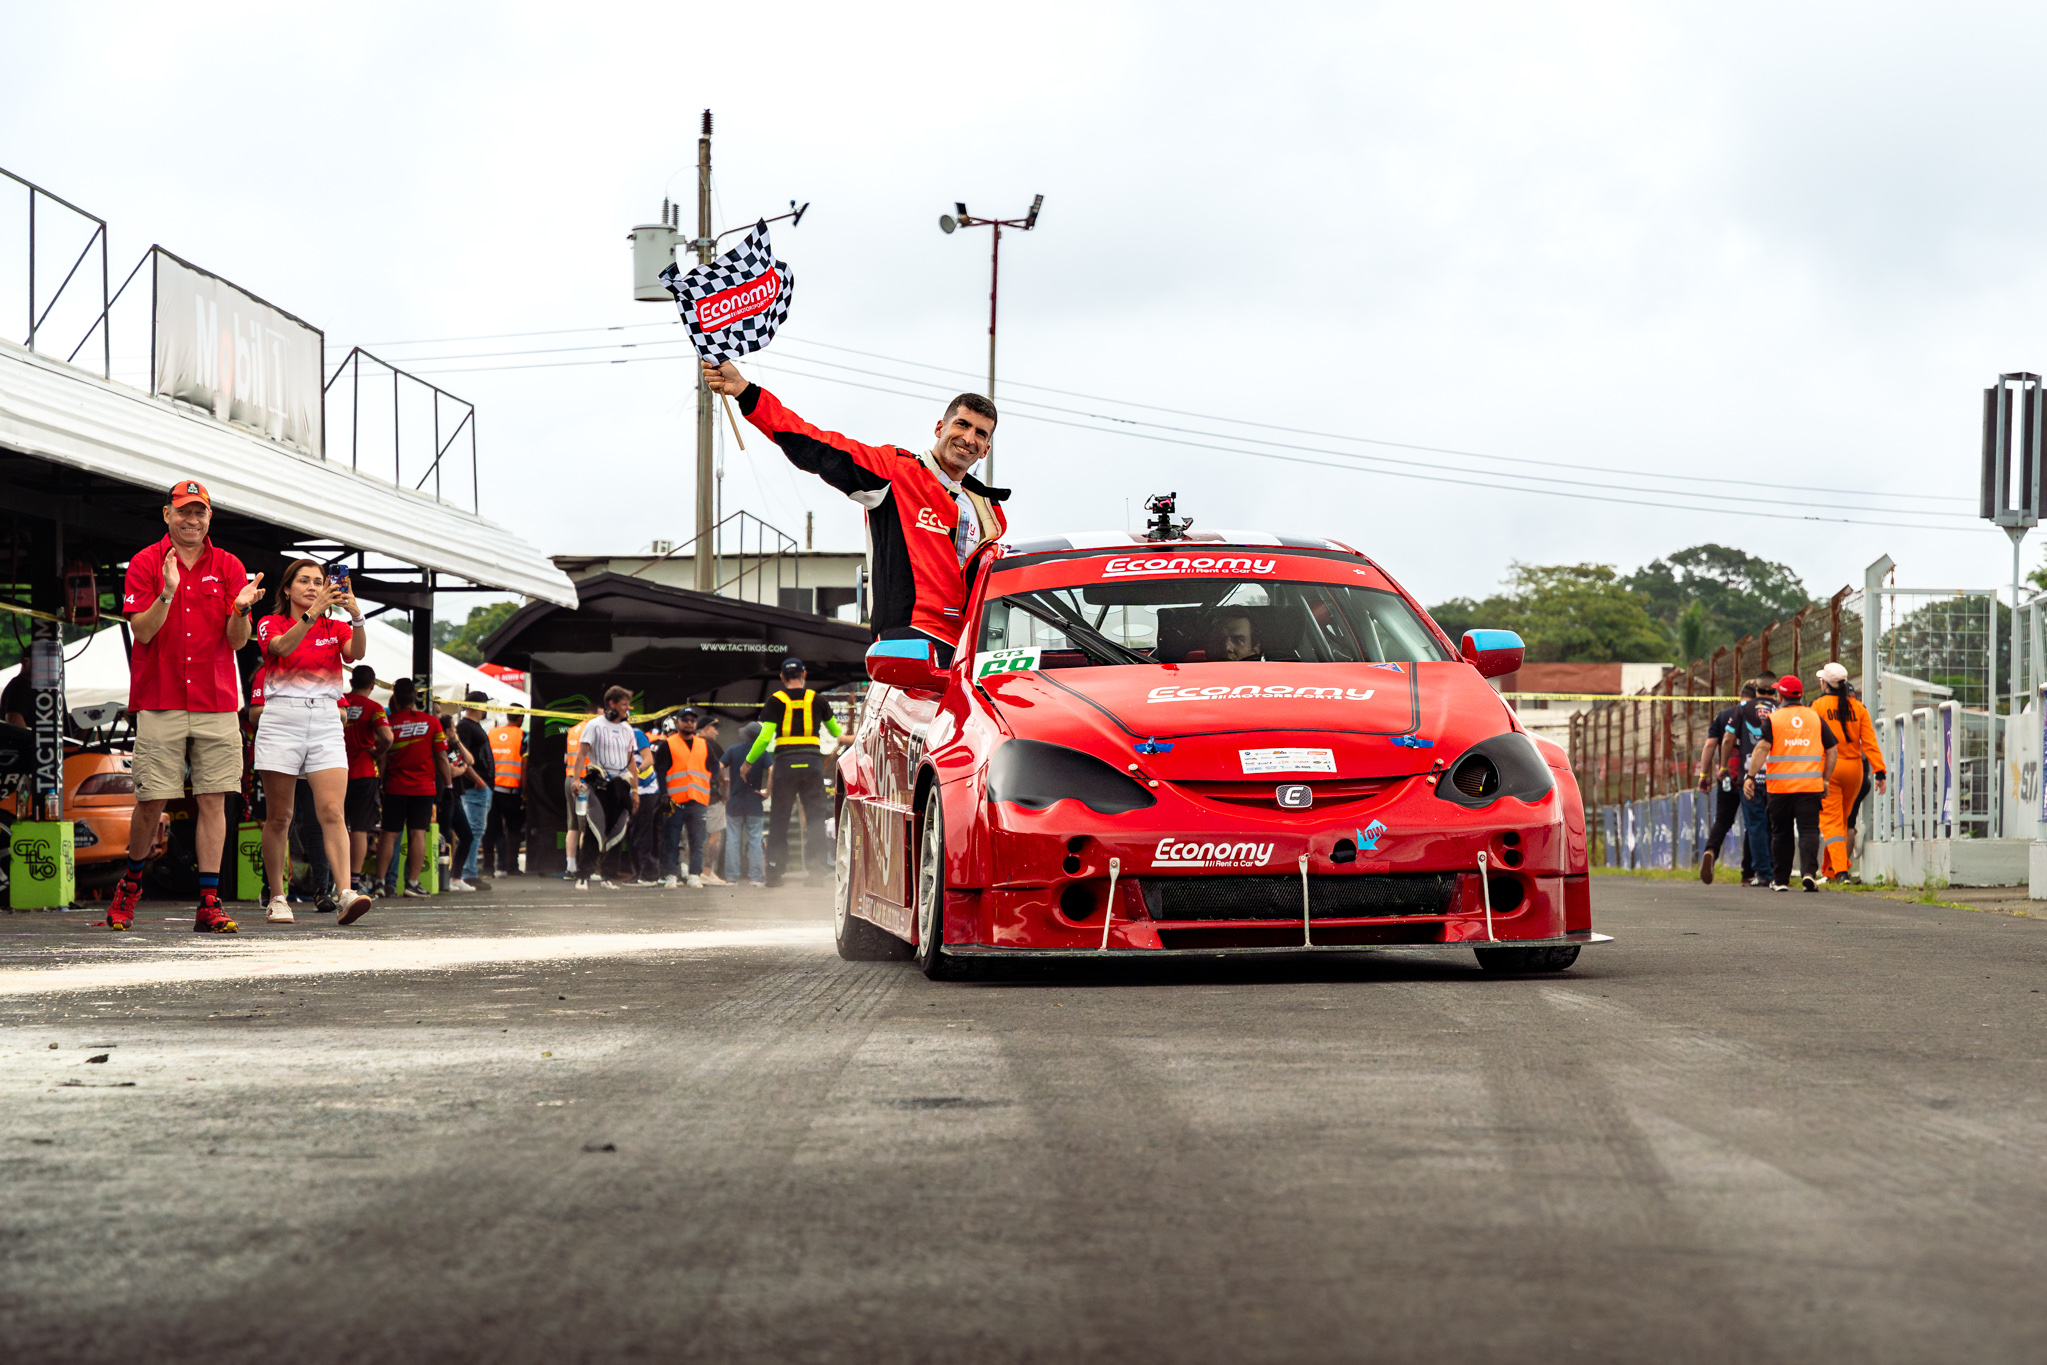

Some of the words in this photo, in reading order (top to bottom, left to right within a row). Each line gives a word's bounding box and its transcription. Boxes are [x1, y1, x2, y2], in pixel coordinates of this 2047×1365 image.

[699, 275, 776, 322] Economy
[195, 294, 264, 408] Mobil
[1105, 557, 1277, 574] Economy
[700, 643, 788, 653] WWW.TACTIKOS.COM
[992, 649, 1025, 659] GT3
[1148, 685, 1376, 701] Economy
[398, 724, 430, 738] 28
[1784, 738, 1810, 747] MURO
[1284, 786, 1304, 805] E
[1359, 825, 1385, 842] TOW
[1154, 837, 1275, 867] Economy
